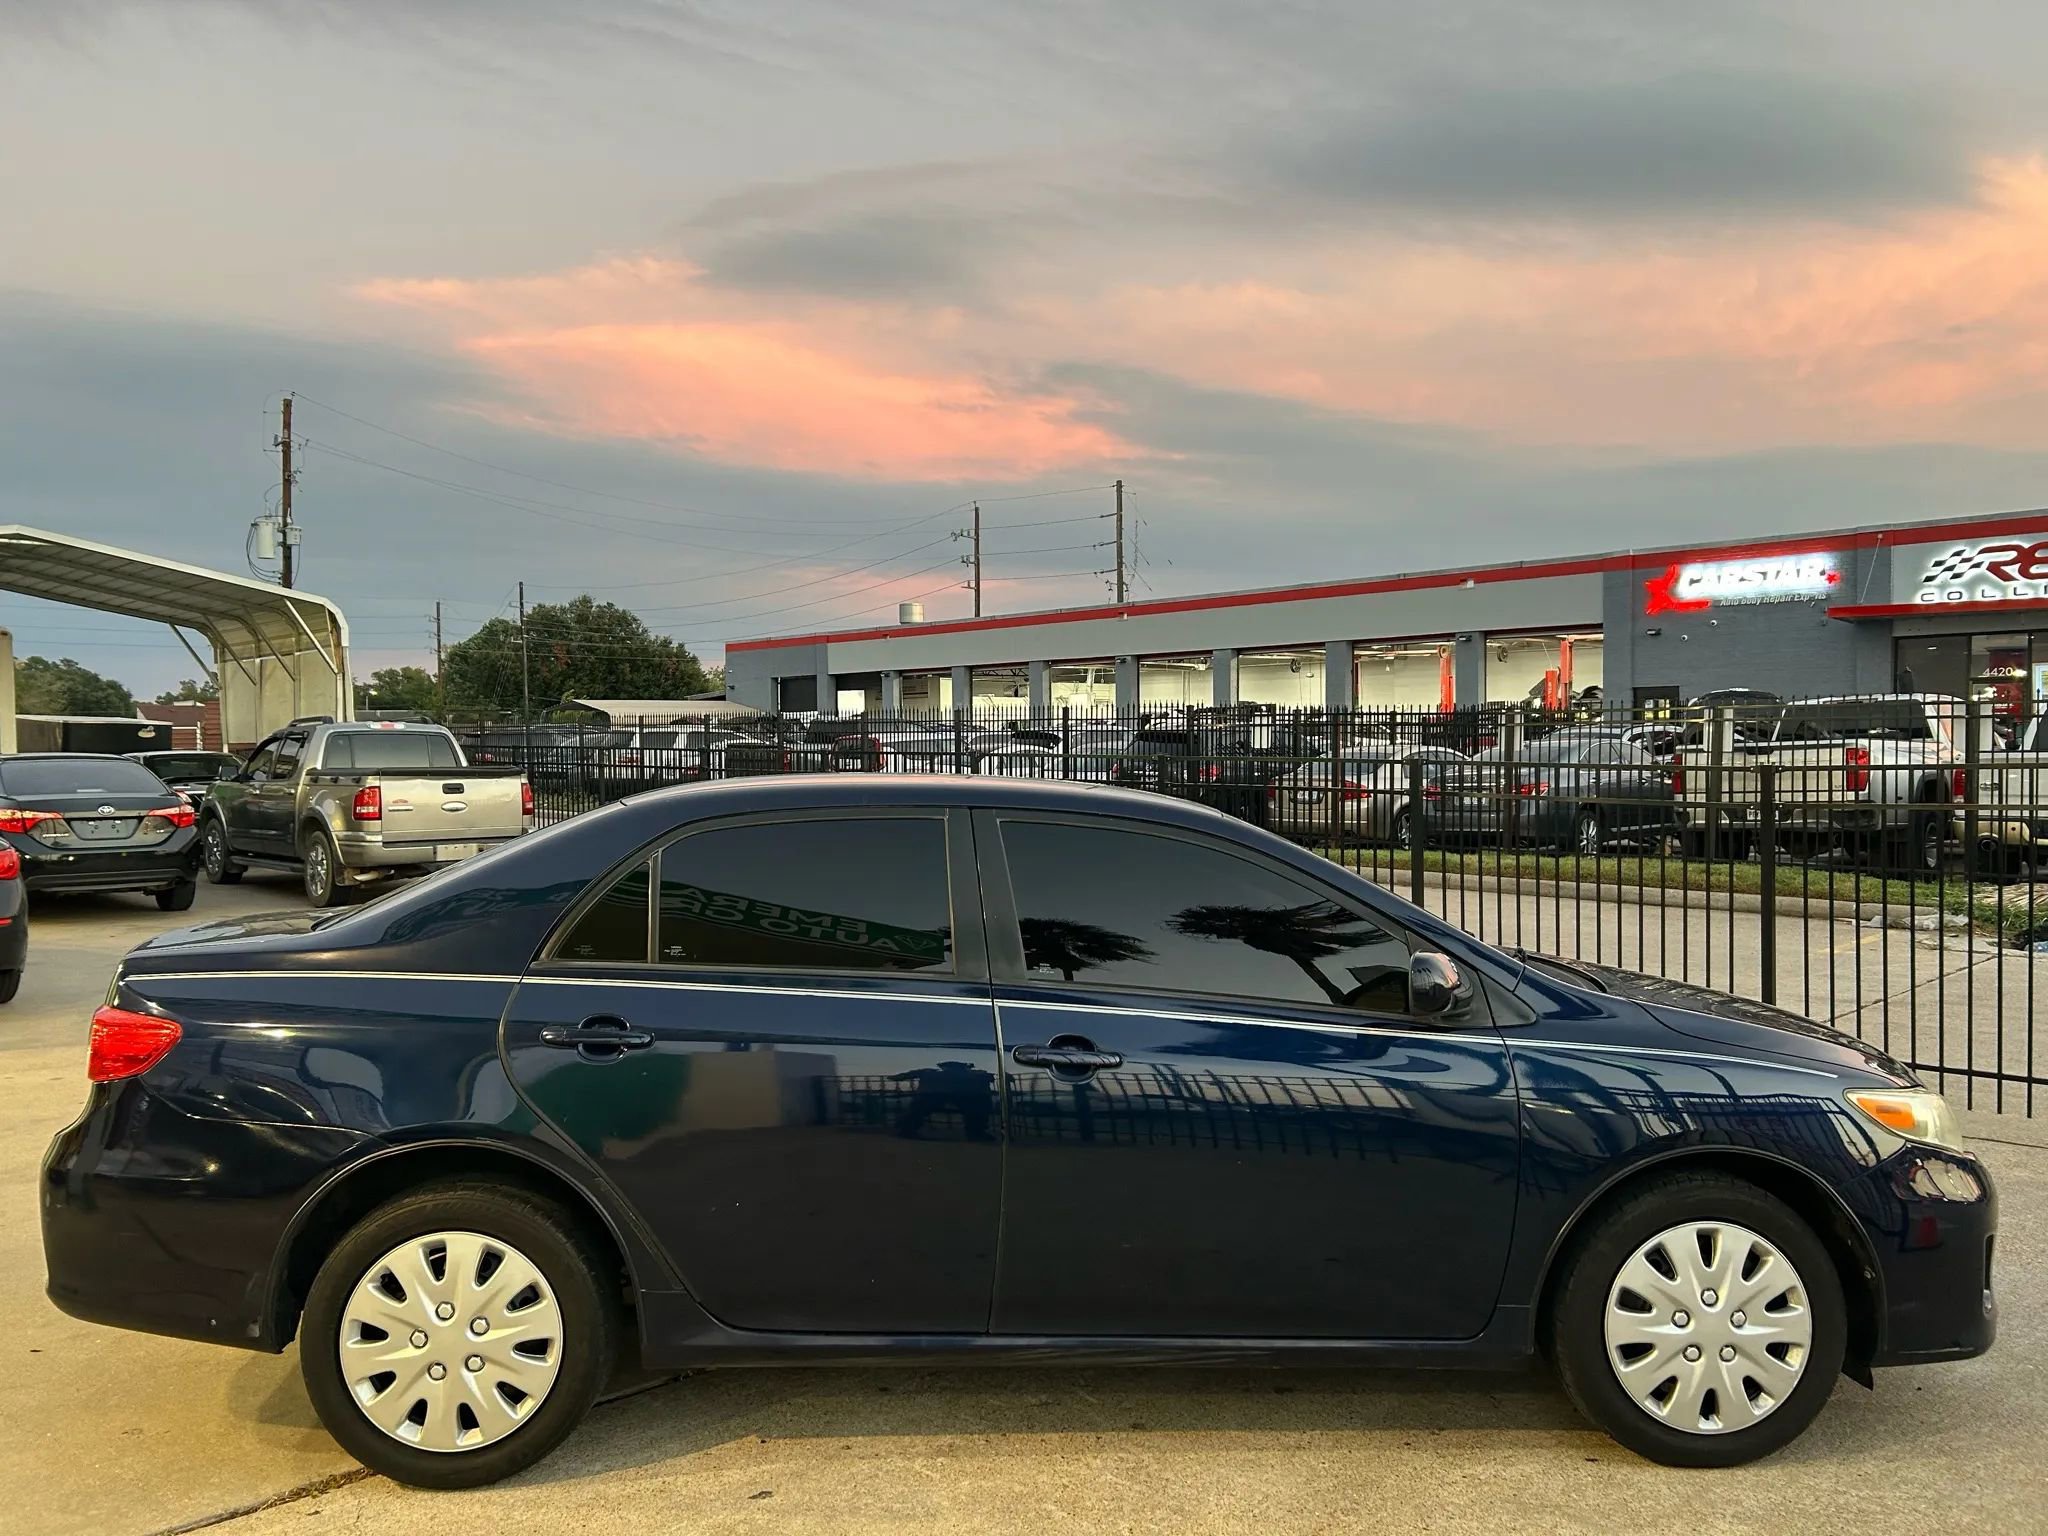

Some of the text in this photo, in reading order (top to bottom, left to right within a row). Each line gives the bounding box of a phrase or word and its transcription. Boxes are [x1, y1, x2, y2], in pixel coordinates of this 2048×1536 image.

[1679, 557, 1826, 593] CARSTAR
[1720, 595, 1739, 607] Auto
[1741, 595, 1761, 606] Body
[1763, 593, 1793, 604] Repair
[1983, 667, 2013, 676] 4420
